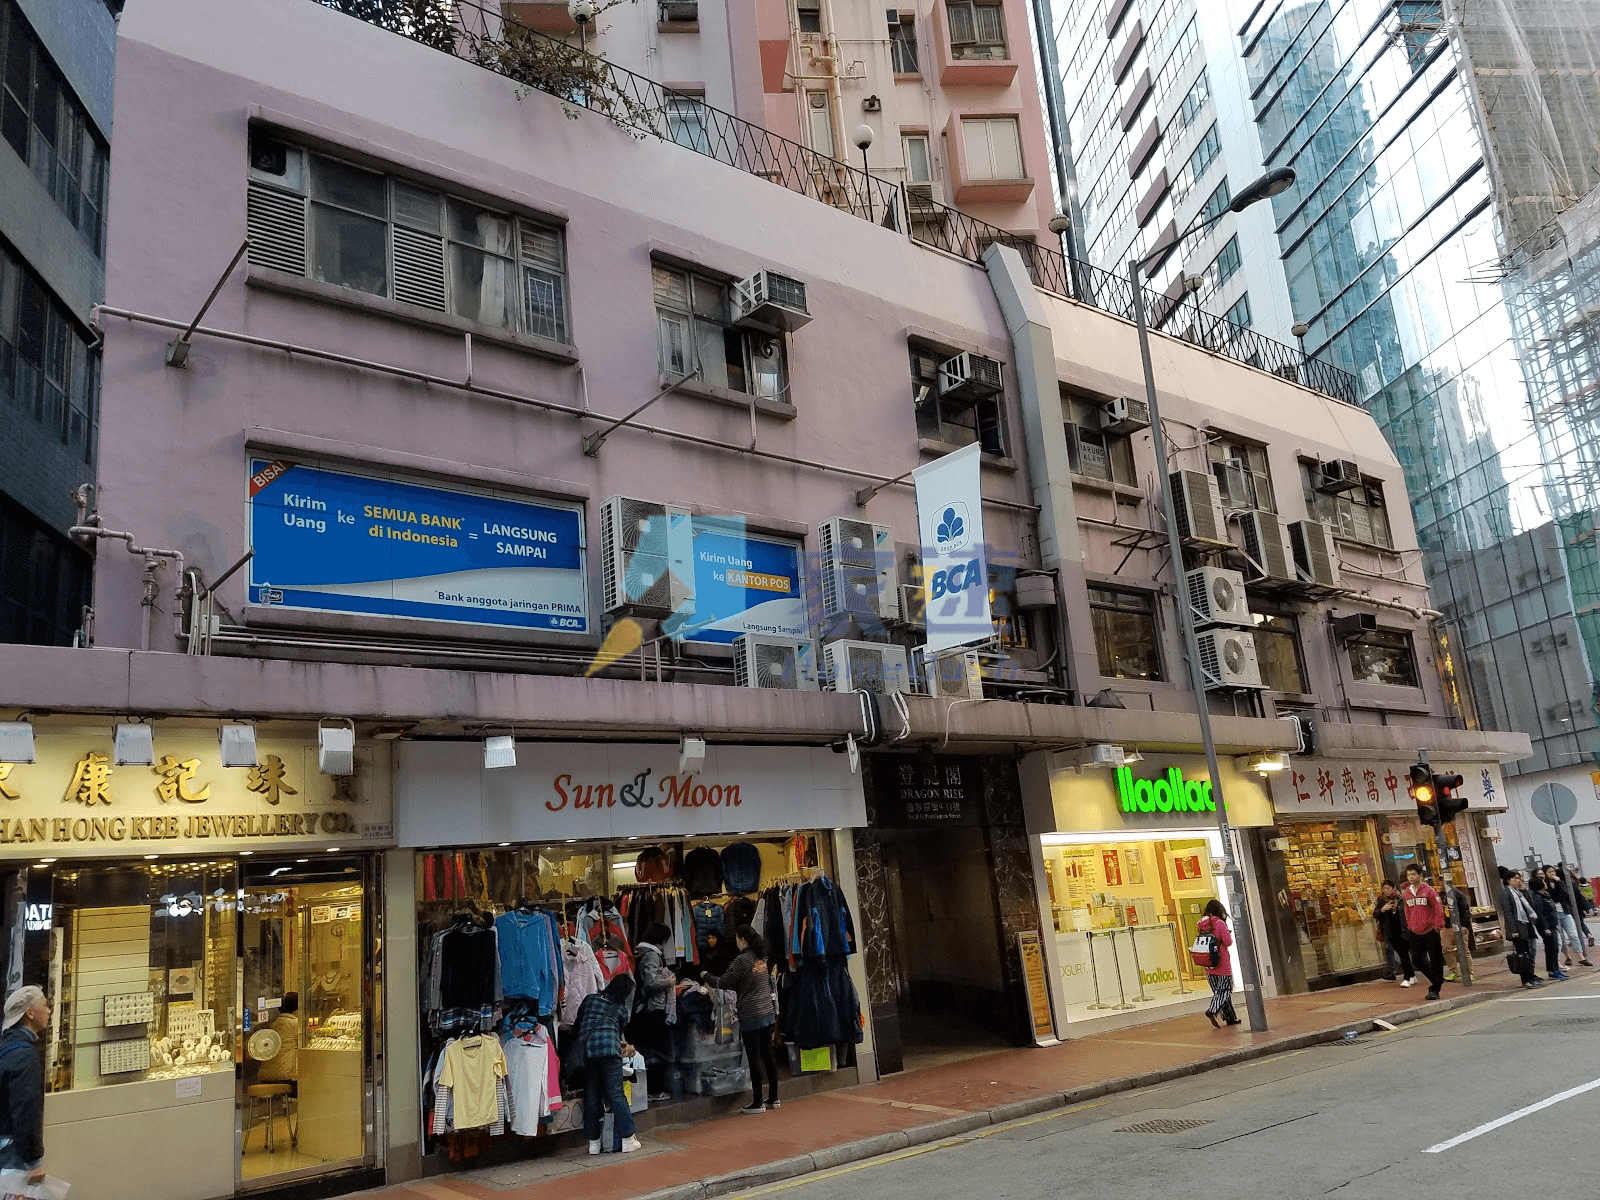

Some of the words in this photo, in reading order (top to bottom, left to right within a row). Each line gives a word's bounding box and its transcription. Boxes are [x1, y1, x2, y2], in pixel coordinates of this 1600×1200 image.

[1081, 444, 1105, 457] ARUNG
[252, 461, 287, 488] BISA!
[283, 493, 327, 511] Kirim
[283, 512, 327, 533] Uang
[337, 510, 356, 525] ke
[363, 504, 418, 524] SEMUA
[368, 524, 384, 538] di
[386, 525, 458, 548] Indonesia
[483, 522, 557, 544] LANGSUNG
[496, 541, 547, 559] SAMPAI
[700, 551, 726, 564] Kirim
[727, 555, 753, 570] Uang
[712, 570, 725, 582] ke
[727, 572, 768, 587] KANTOR
[769, 577, 789, 589] POS
[931, 558, 982, 602] BCA
[466, 596, 508, 607] anggota
[509, 598, 549, 612] jaringan
[551, 602, 582, 614] PRIMA
[559, 618, 578, 628] BCA
[742, 622, 777, 633] Langsung
[777, 625, 803, 635] Sampai
[545, 774, 616, 811] Sun
[619, 768, 654, 808] &
[658, 774, 742, 808] Moon
[901, 788, 940, 799] DRAGON
[943, 788, 964, 799] RISE
[51, 816, 127, 842] HONG
[131, 815, 180, 840] KEE
[184, 812, 320, 839] JEWELLERY
